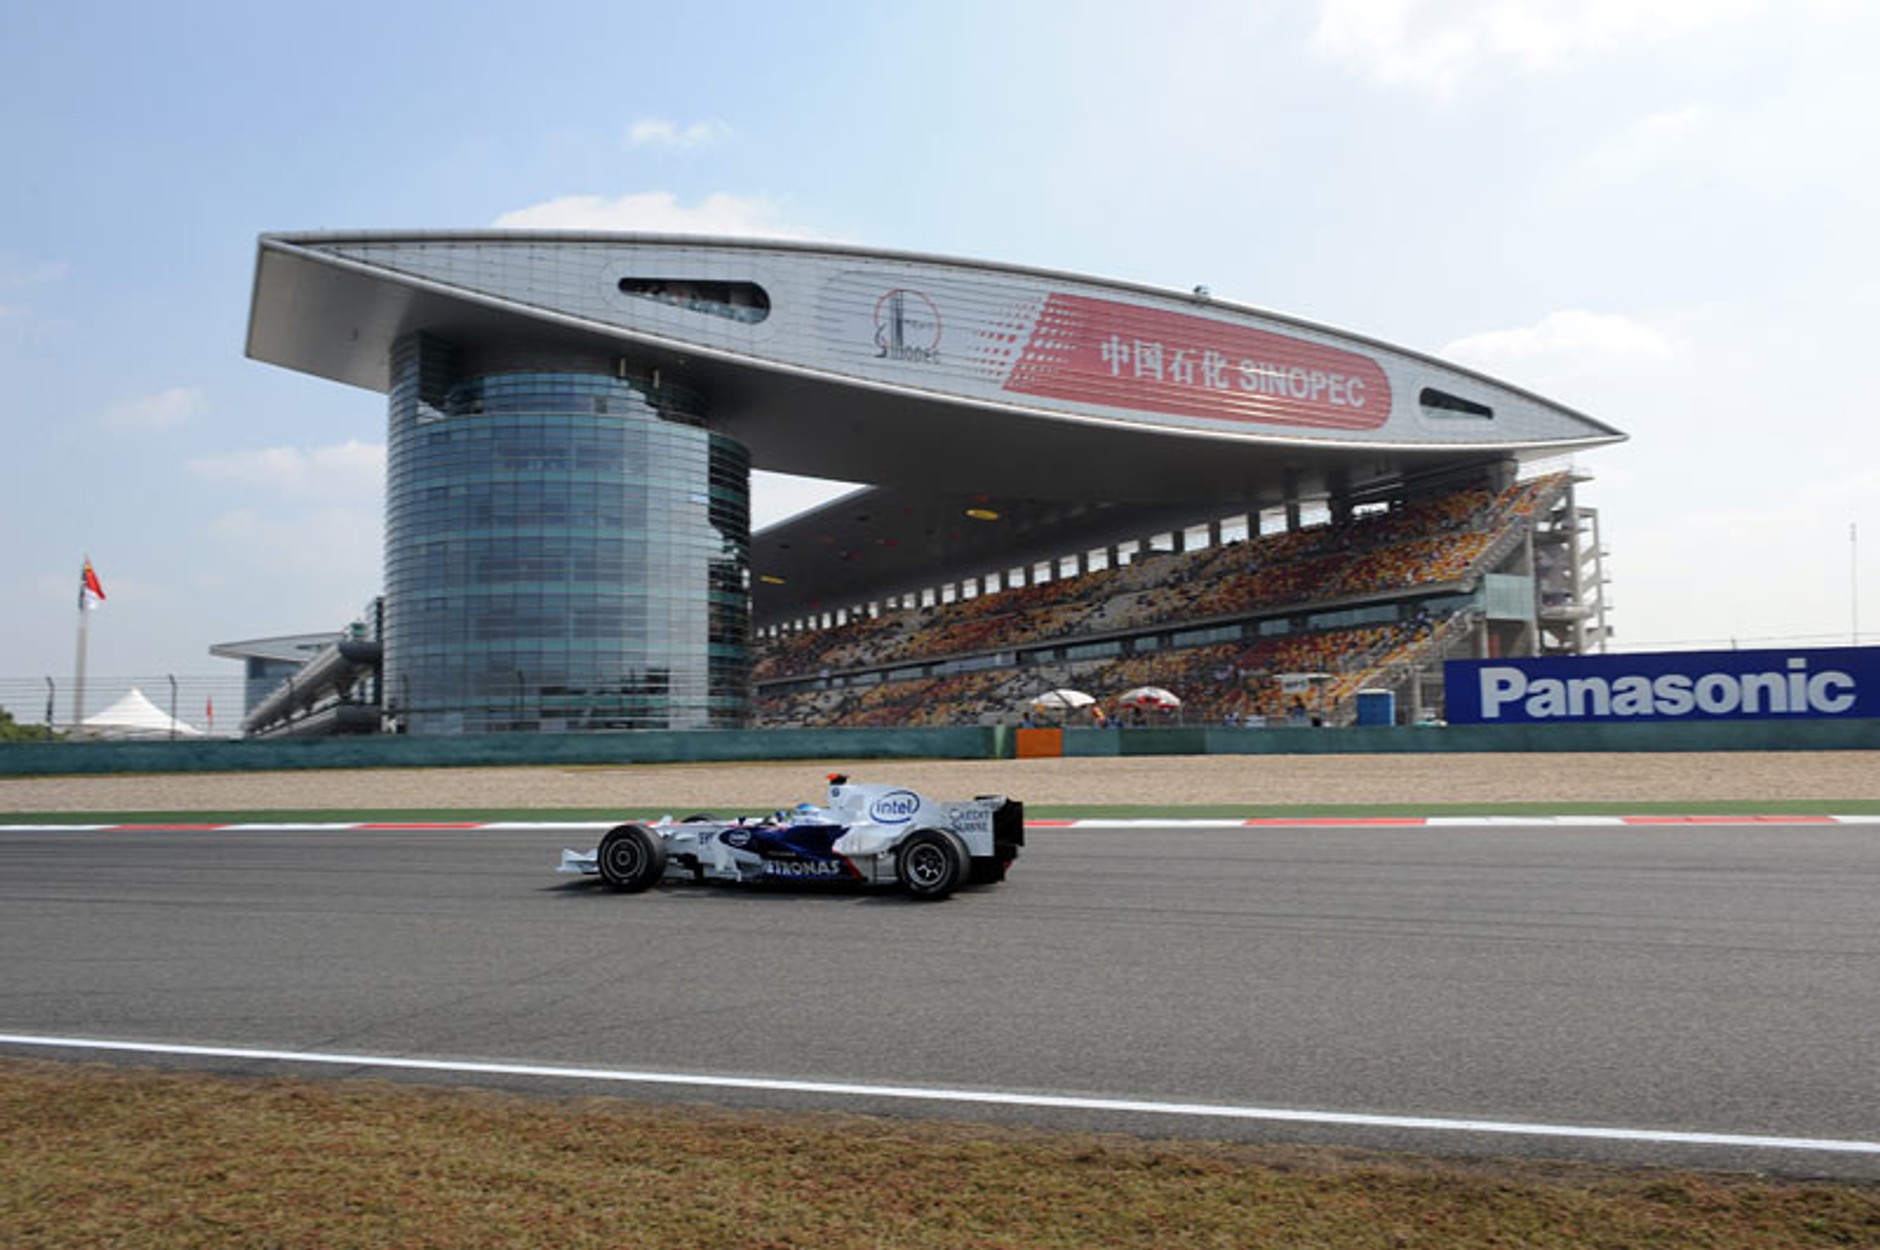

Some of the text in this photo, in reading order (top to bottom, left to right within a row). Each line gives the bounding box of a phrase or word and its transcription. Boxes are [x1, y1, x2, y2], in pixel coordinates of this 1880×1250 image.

[1101, 334, 1365, 408] 中国石化 SINOPEC
[1478, 657, 1857, 719] Panasonic
[876, 799, 912, 815] intel
